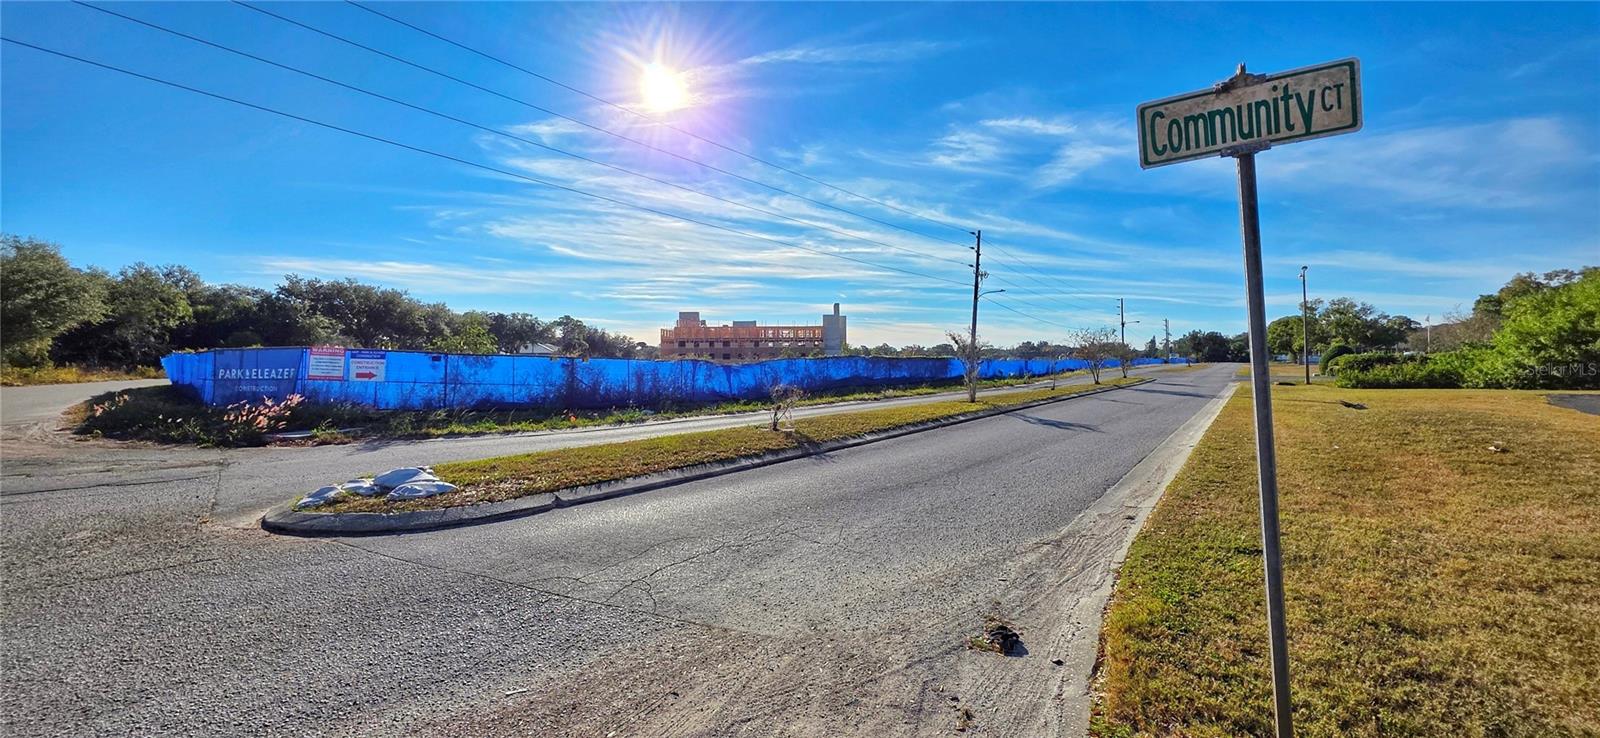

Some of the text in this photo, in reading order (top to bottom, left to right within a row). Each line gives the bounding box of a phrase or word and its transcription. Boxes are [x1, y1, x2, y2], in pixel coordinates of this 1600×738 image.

[1150, 83, 1344, 157] Community CT
[218, 368, 244, 380] PARK
